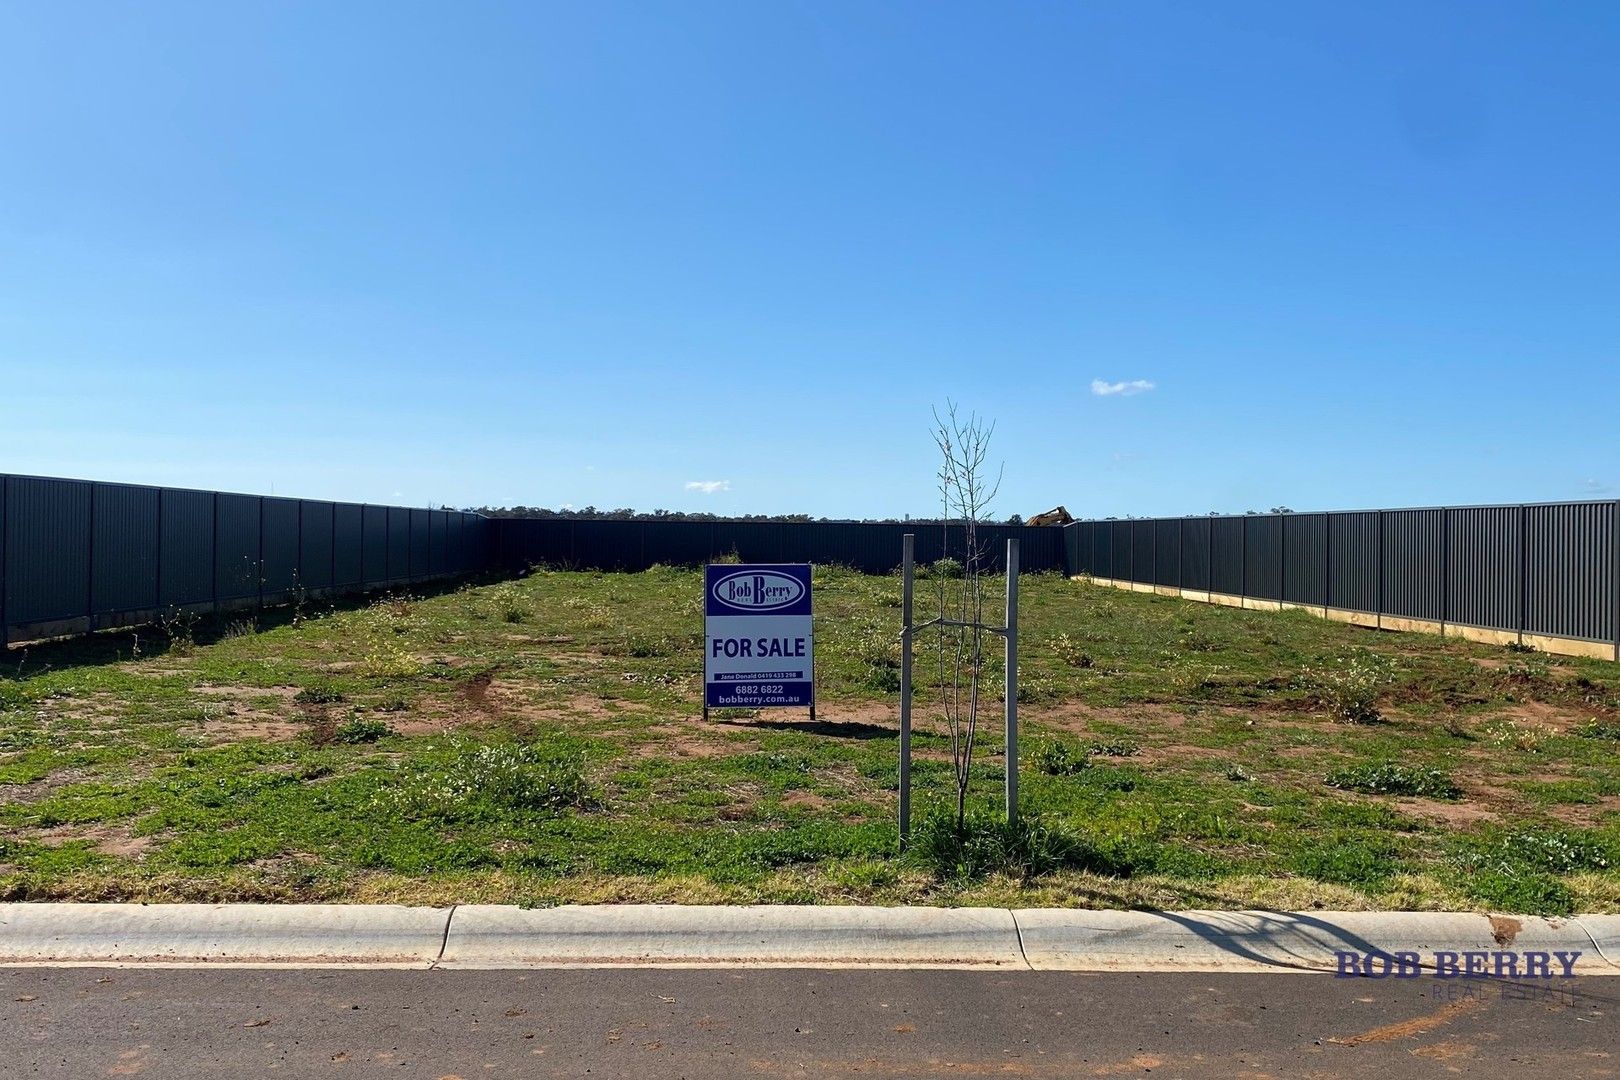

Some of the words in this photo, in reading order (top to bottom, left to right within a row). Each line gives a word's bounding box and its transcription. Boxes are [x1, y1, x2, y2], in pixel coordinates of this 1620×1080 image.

[728, 580, 751, 600] Bob
[752, 576, 792, 604] Berry
[712, 638, 753, 658] FOR
[756, 637, 806, 658] SALE
[735, 685, 759, 694] 6882
[760, 685, 784, 694] 6822
[718, 695, 800, 705] bobberry.com.au
